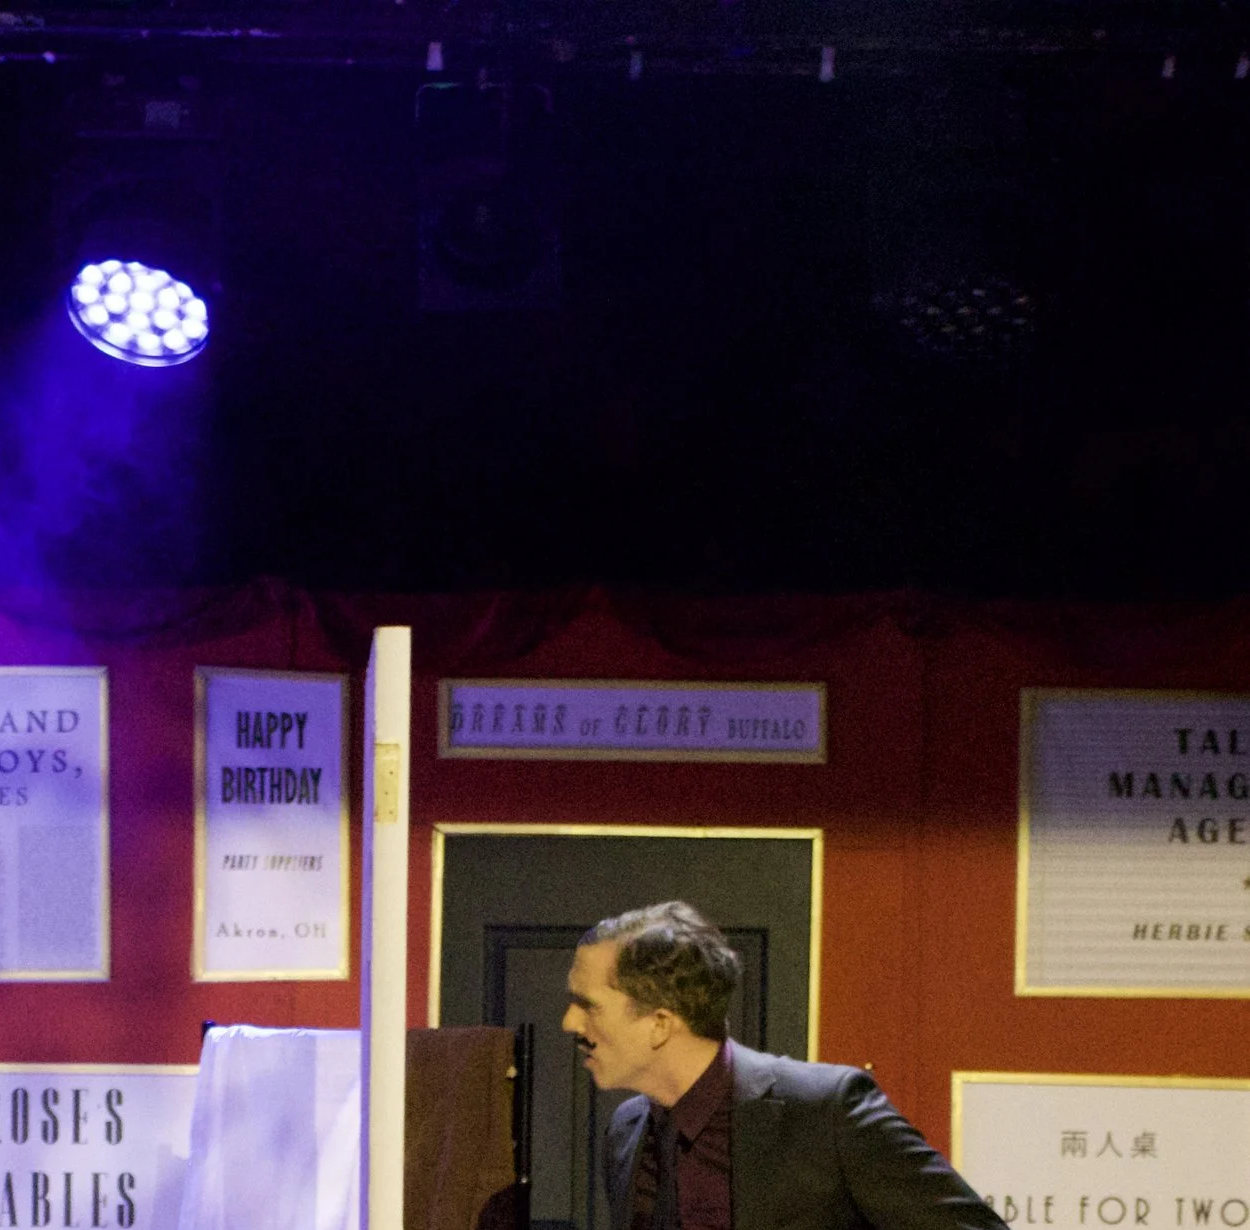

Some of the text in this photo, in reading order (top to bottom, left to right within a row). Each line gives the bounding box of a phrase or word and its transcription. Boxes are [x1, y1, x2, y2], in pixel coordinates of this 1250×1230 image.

[0, 709, 81, 736] AND
[236, 711, 309, 750] HAPPY
[452, 703, 806, 740] DREAMS OF GLORY BUFFALO
[221, 766, 322, 805] BIRTHDAY
[223, 854, 258, 871] PARTY
[1133, 923, 1228, 942] HERBIE
[1060, 1129, 1159, 1159] 兩人桌
[1079, 1195, 1151, 1226] FOR
[1175, 1197, 1250, 1228] TWO
